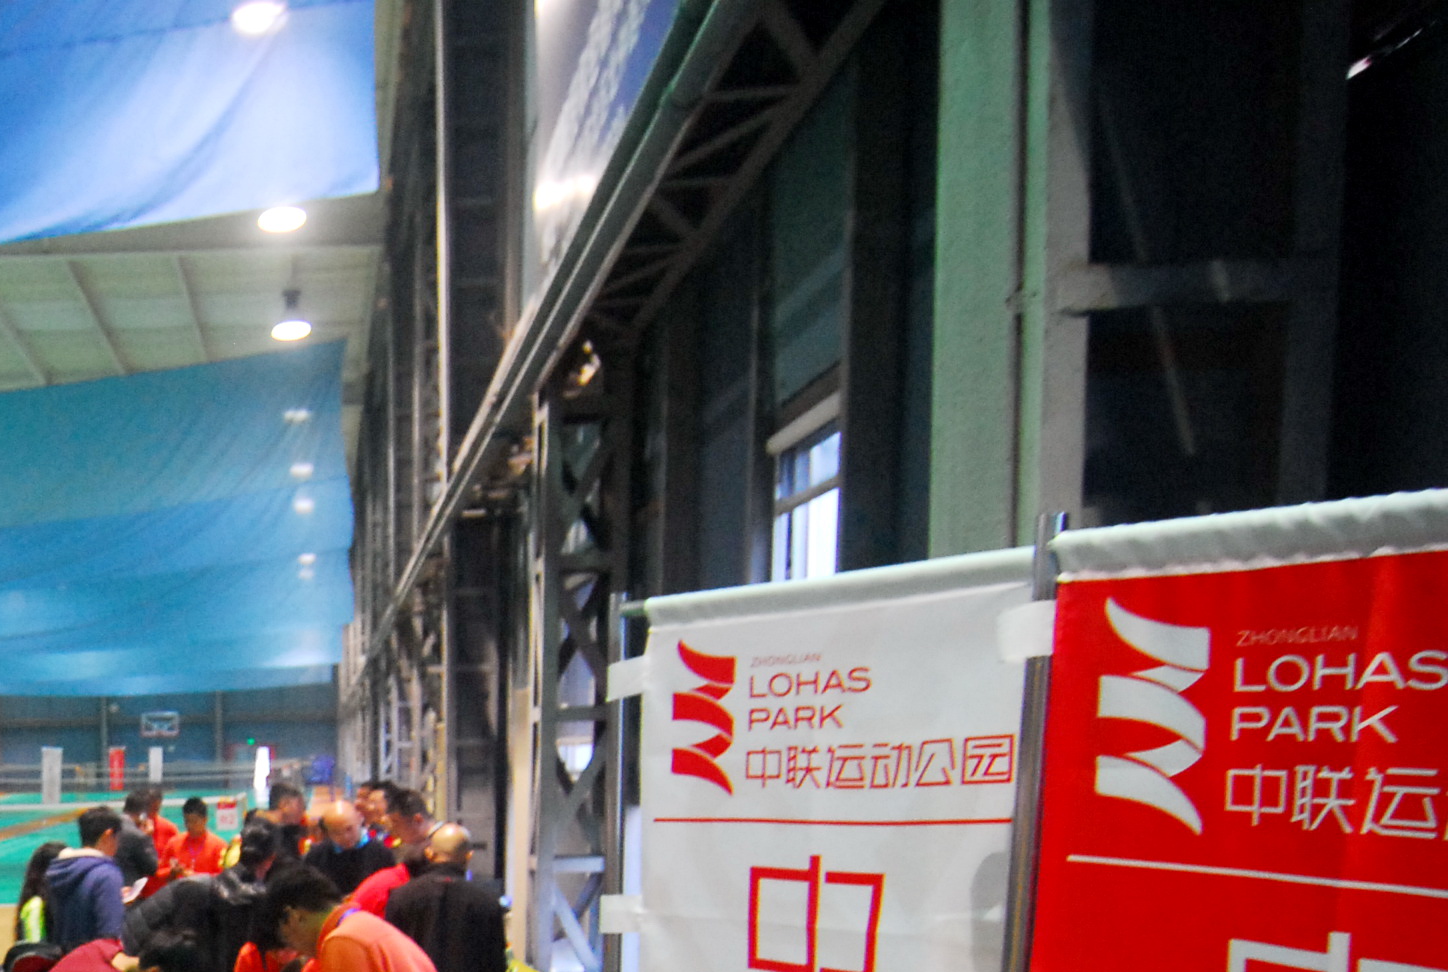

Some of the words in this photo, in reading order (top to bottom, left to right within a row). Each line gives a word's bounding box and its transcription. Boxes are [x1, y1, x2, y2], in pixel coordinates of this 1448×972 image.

[1235, 625, 1359, 647] ZHONGLIAN
[749, 667, 872, 698] LOHAS
[1233, 649, 1448, 692] LOHAS
[748, 704, 843, 732] PARK
[1230, 705, 1400, 743] PARK
[745, 734, 1016, 789] 中联运动公园
[1224, 763, 1448, 841] 中联运
